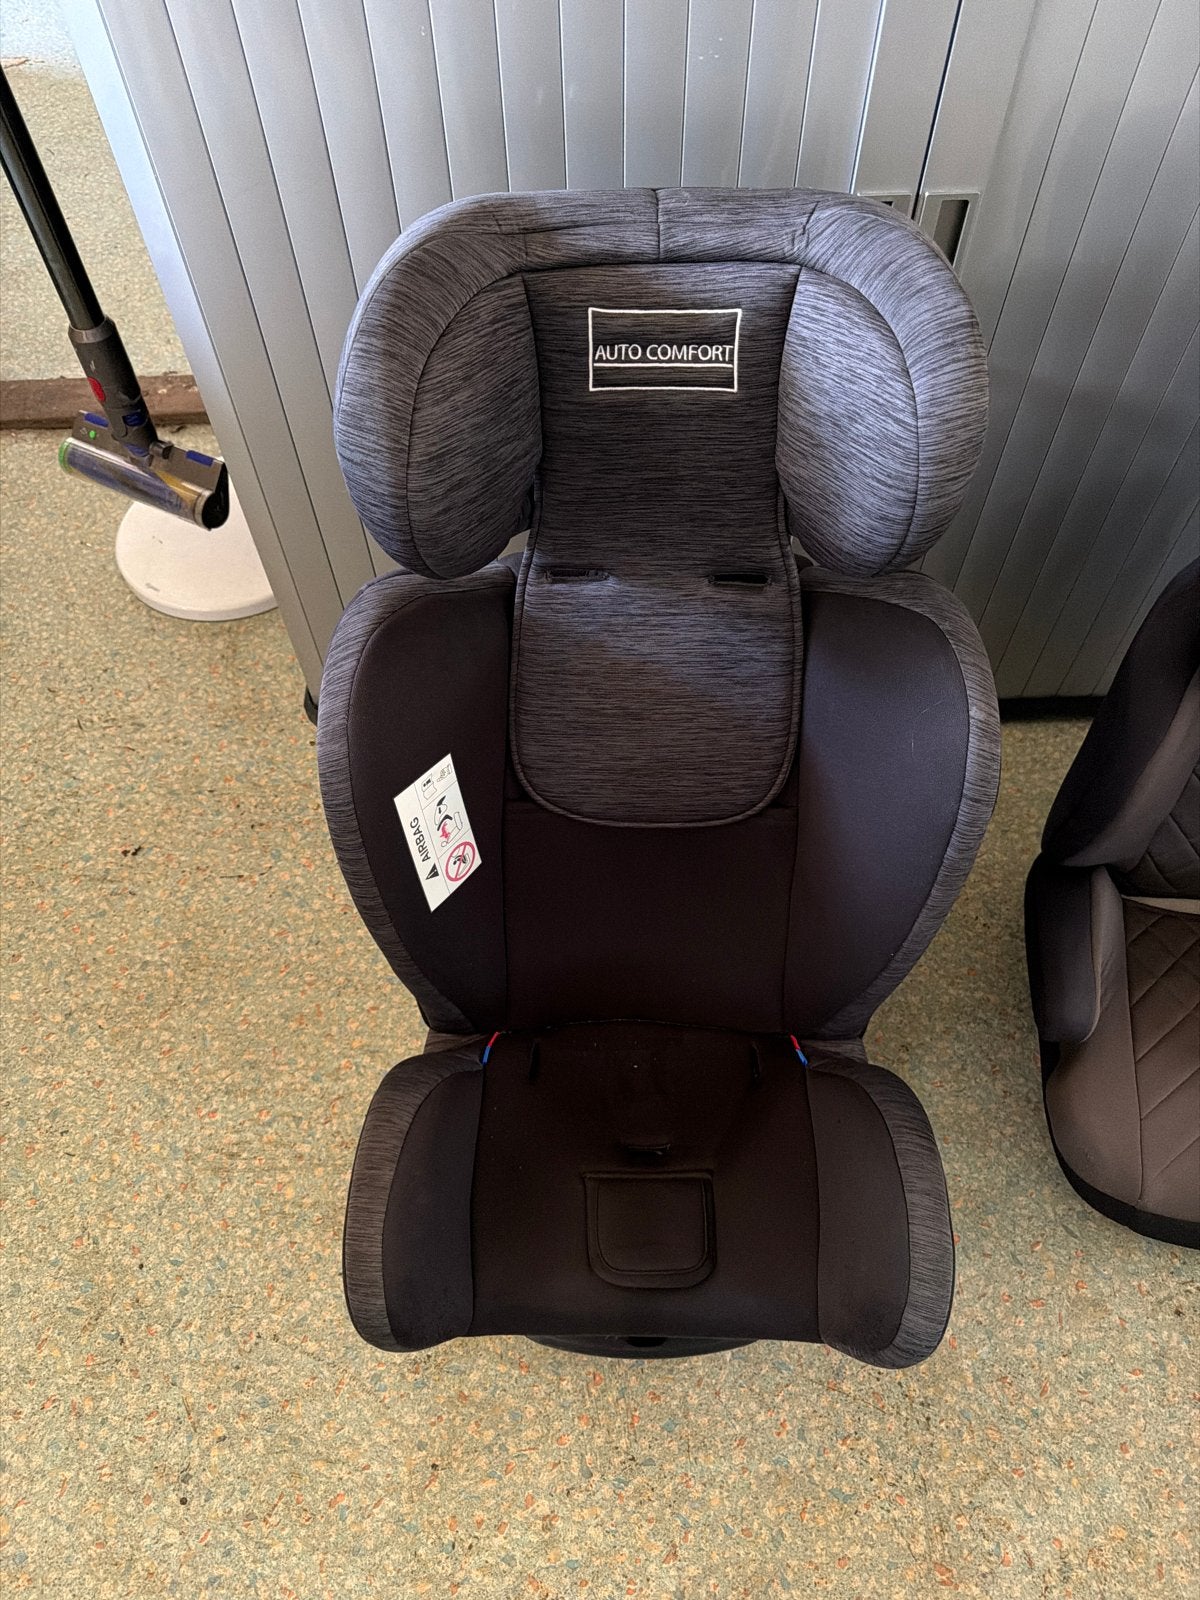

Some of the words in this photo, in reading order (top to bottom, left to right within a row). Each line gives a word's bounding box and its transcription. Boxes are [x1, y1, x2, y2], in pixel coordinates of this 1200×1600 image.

[594, 344, 642, 361] AUTO
[646, 344, 734, 362] COMFORT
[410, 816, 431, 863] AIRBAG
